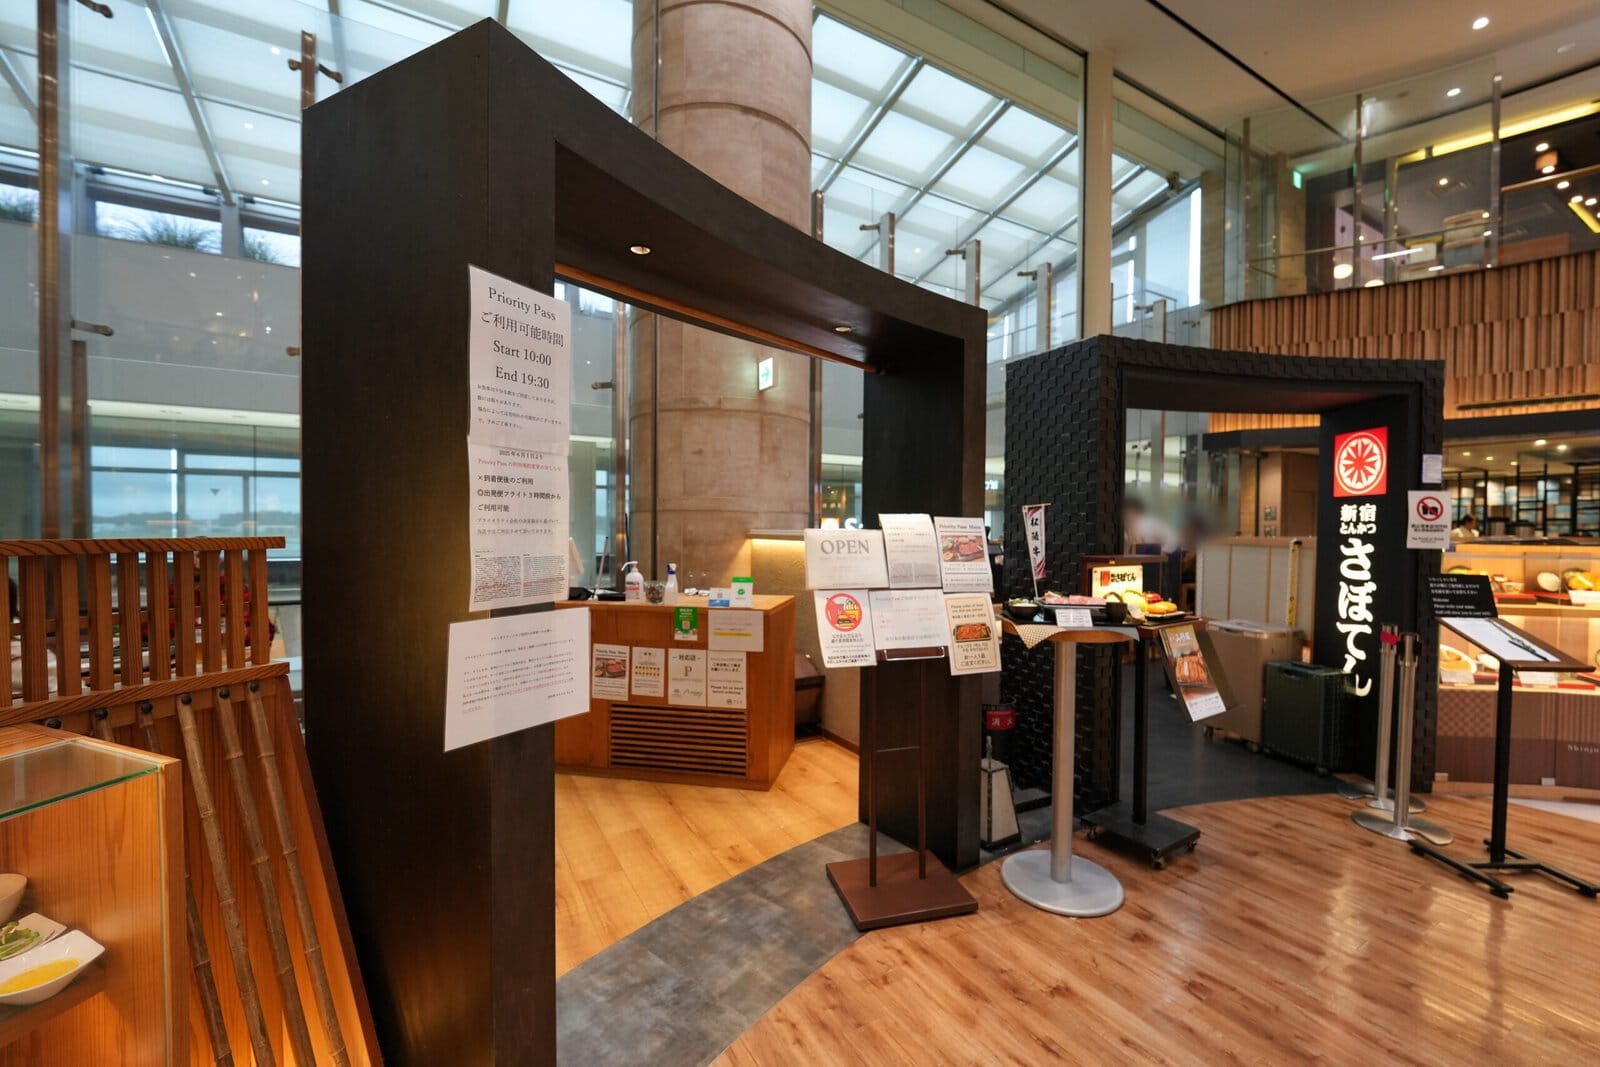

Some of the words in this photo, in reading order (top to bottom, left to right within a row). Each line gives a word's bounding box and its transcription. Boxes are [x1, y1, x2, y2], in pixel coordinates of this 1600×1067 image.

[488, 287, 531, 314] Priority
[534, 304, 556, 321] Pass
[481, 311, 564, 347] ご利用可能時間
[493, 340, 520, 358] Start
[524, 349, 552, 366] 10:00
[495, 366, 518, 382] End
[522, 373, 550, 389] 19:30
[478, 503, 510, 513] ご利用可能
[1340, 503, 1377, 522] 新宿
[1339, 522, 1377, 535] とんかつ
[820, 539, 870, 555] OPEN
[1336, 537, 1377, 696] さぼてん
